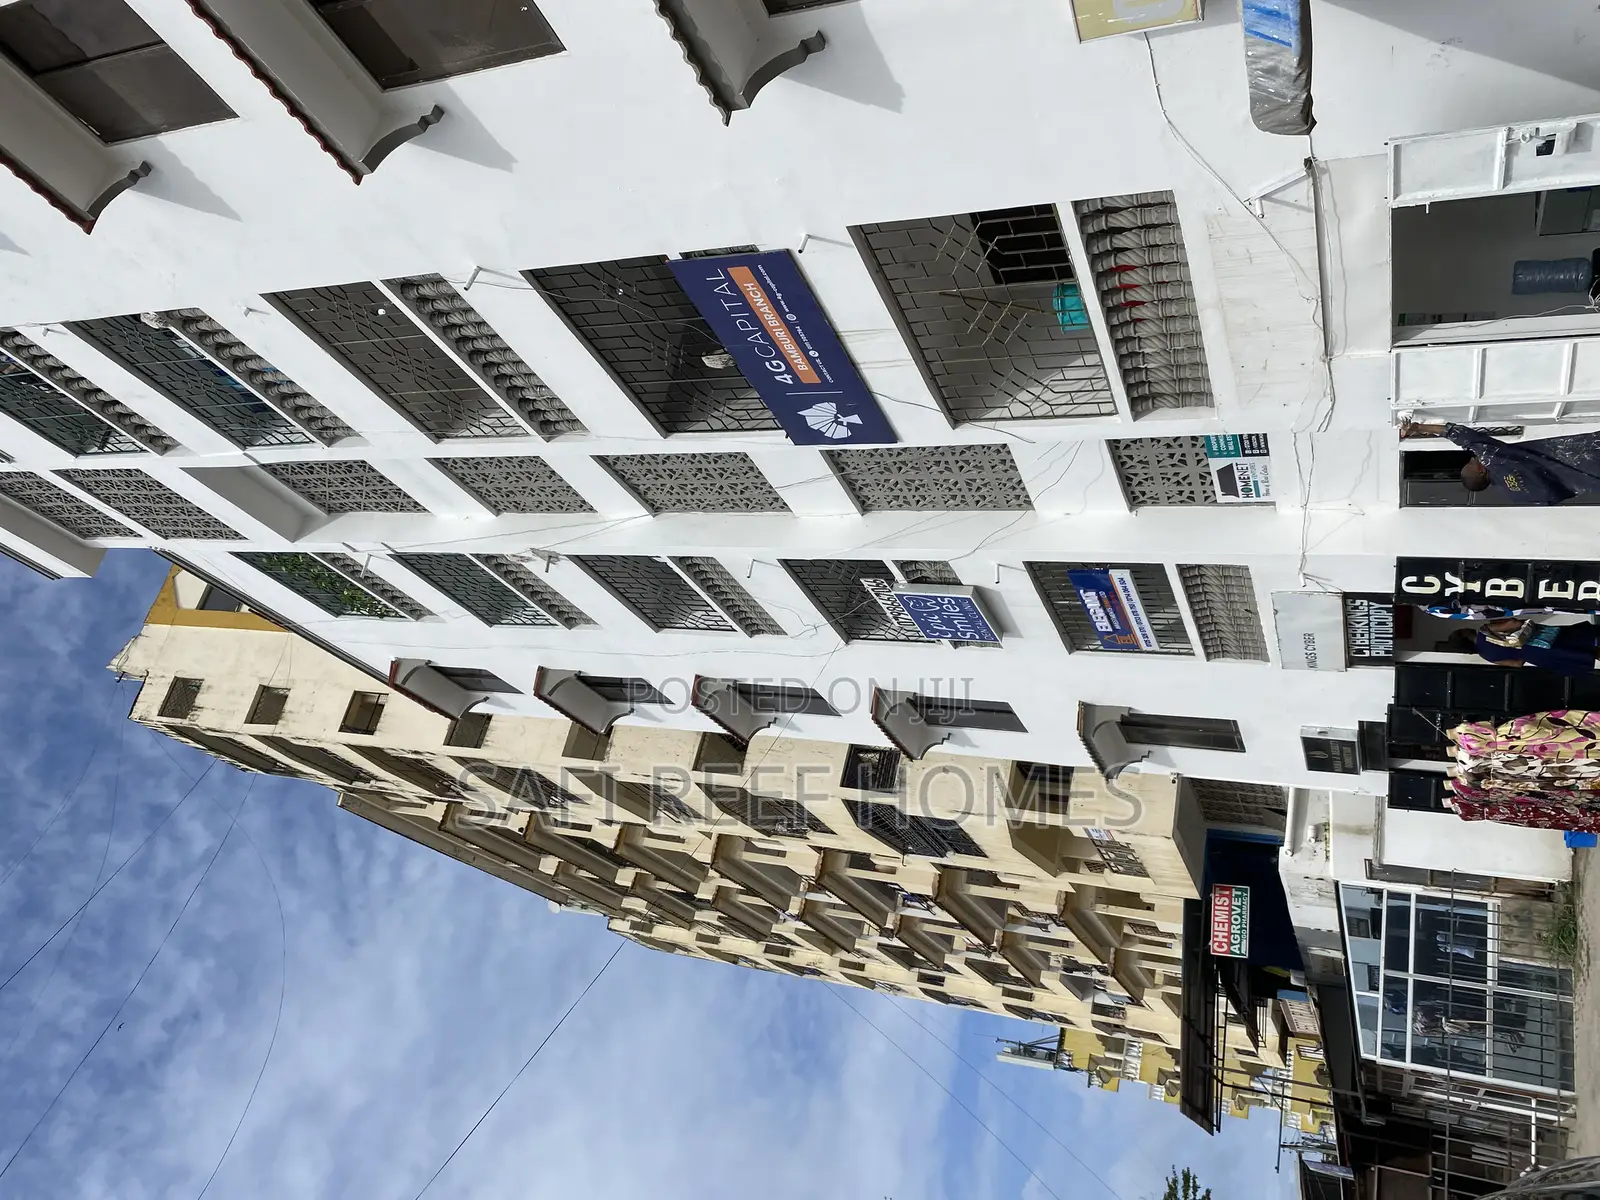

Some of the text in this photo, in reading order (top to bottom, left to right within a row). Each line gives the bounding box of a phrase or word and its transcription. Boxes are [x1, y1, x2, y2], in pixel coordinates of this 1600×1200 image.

[744, 282, 808, 370] BAMBURI BRANCH
[818, 364, 834, 383] CONTACT
[1236, 463, 1254, 498] HOMENET
[920, 612, 955, 638] Epic
[937, 598, 980, 639] Smiles
[958, 599, 994, 640] DENTAL CLINIC
[1369, 601, 1394, 657] PHOTOCOPY
[1303, 633, 1318, 669] KINGS CYBER
[1213, 888, 1230, 952] CHEMIST
[1230, 888, 1242, 954] AGROVET
